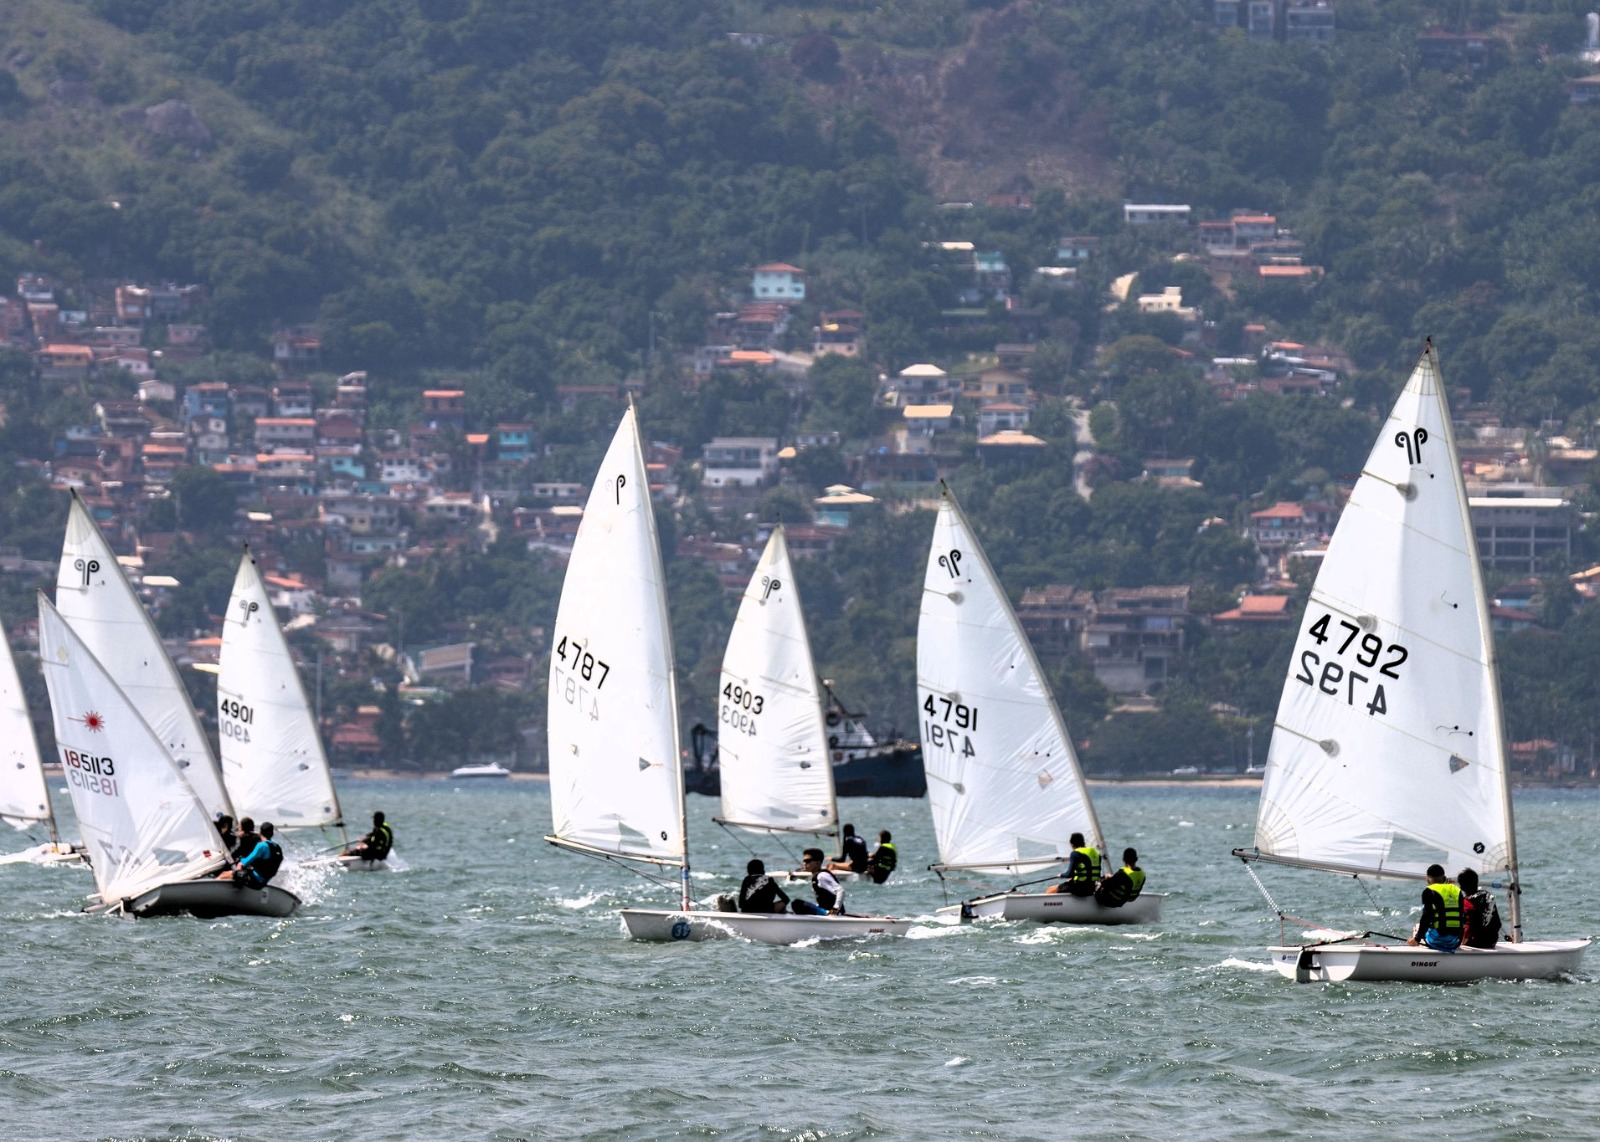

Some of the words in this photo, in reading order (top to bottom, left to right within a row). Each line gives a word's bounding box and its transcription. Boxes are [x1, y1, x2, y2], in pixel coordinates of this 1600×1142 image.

[556, 635, 610, 690] 4787
[1308, 613, 1409, 681] 4792
[220, 698, 254, 725] 4901
[723, 682, 765, 715] 4903
[923, 693, 978, 732] 4791
[63, 748, 115, 776] 185113
